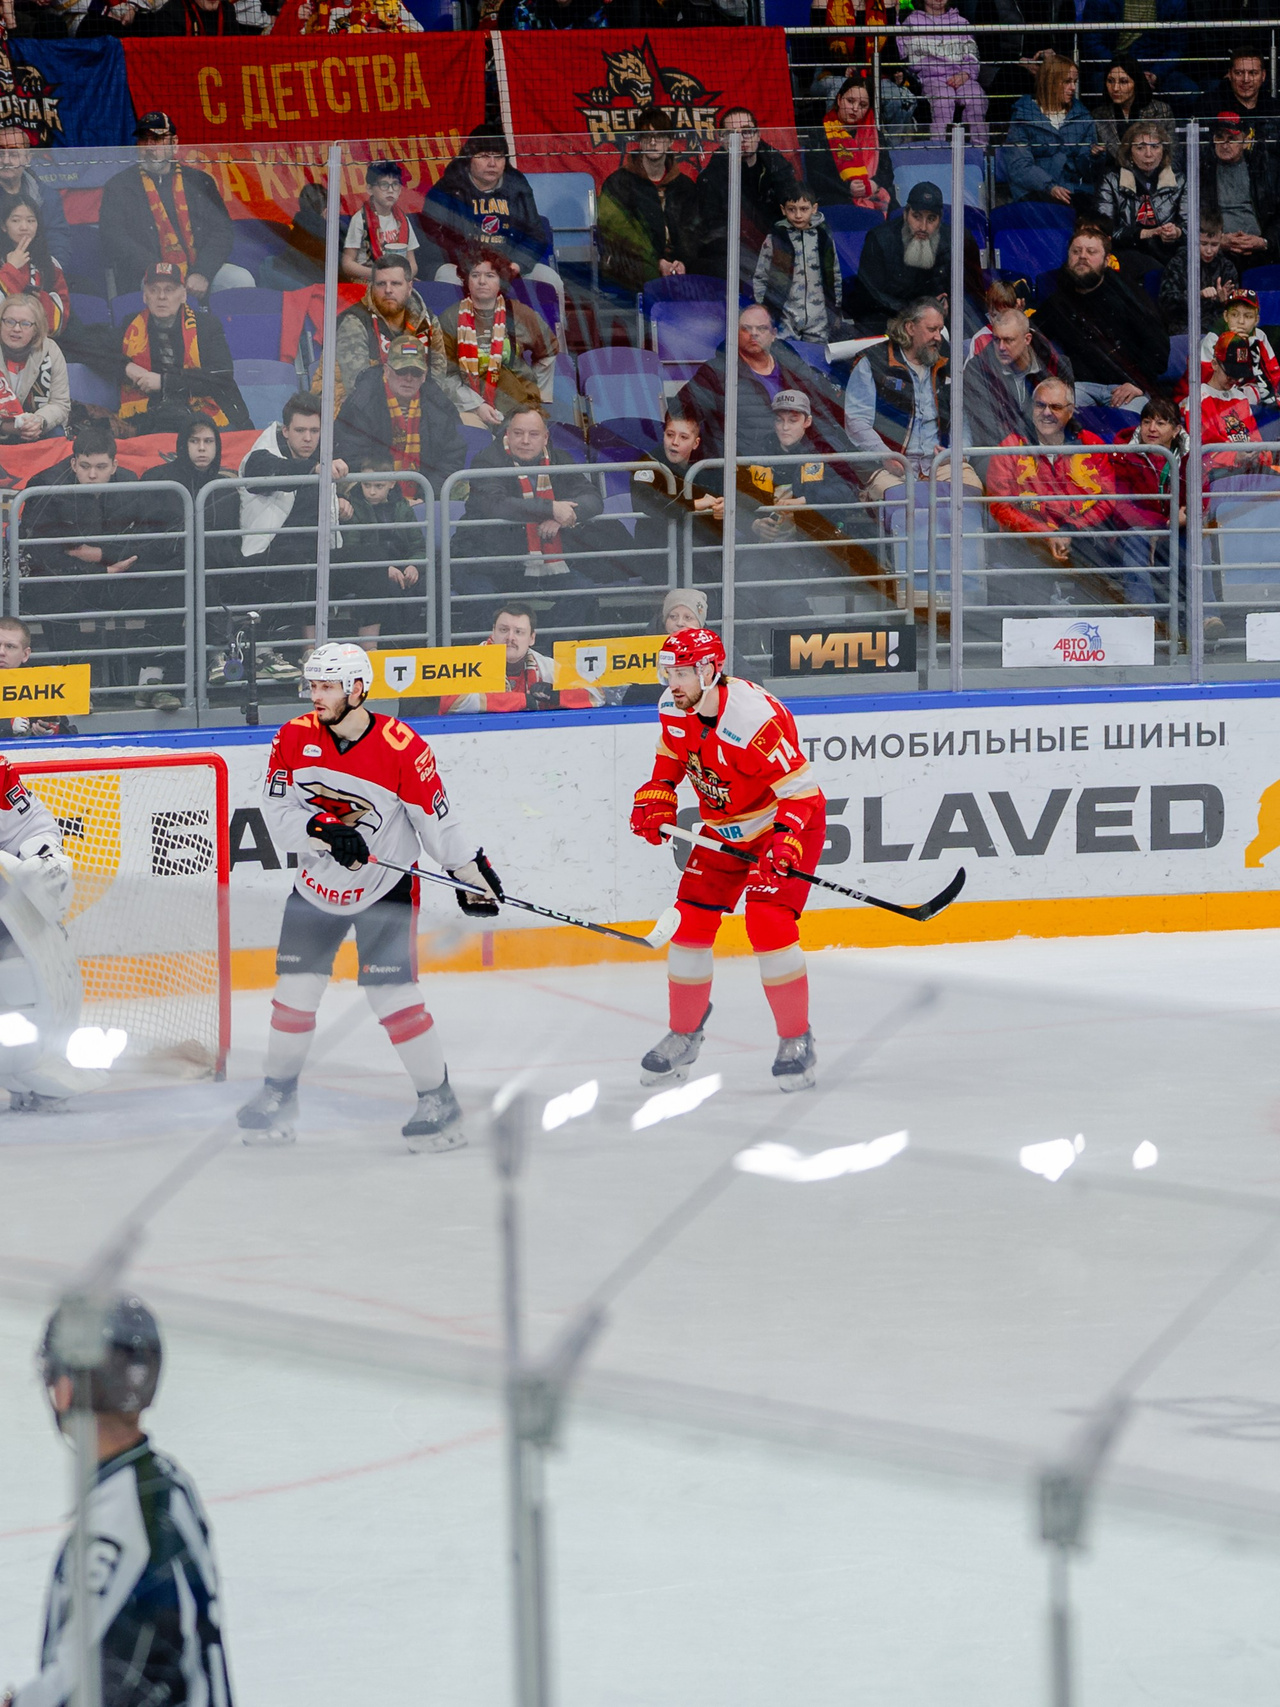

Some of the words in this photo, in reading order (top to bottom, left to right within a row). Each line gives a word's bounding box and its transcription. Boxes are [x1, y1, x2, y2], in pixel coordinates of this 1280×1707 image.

[198, 67, 228, 124] С
[242, 52, 431, 131] ДЕТСТВА
[789, 631, 899, 672] МАТЧ!
[1053, 637, 1088, 650] АВТО
[1063, 649, 1106, 662] РАДИО
[422, 661, 482, 679] БАНК
[612, 652, 658, 670] БАН
[2, 683, 66, 701] БАНК
[767, 737, 798, 773] 74
[803, 725, 1089, 763] ТОМОБИЛЬНЫЕ
[1104, 721, 1226, 749] ШИНЫ
[5, 784, 33, 815] 5
[433, 789, 450, 820] 6
[673, 784, 1225, 875] SLAVED
[819, 880, 868, 901] CCM
